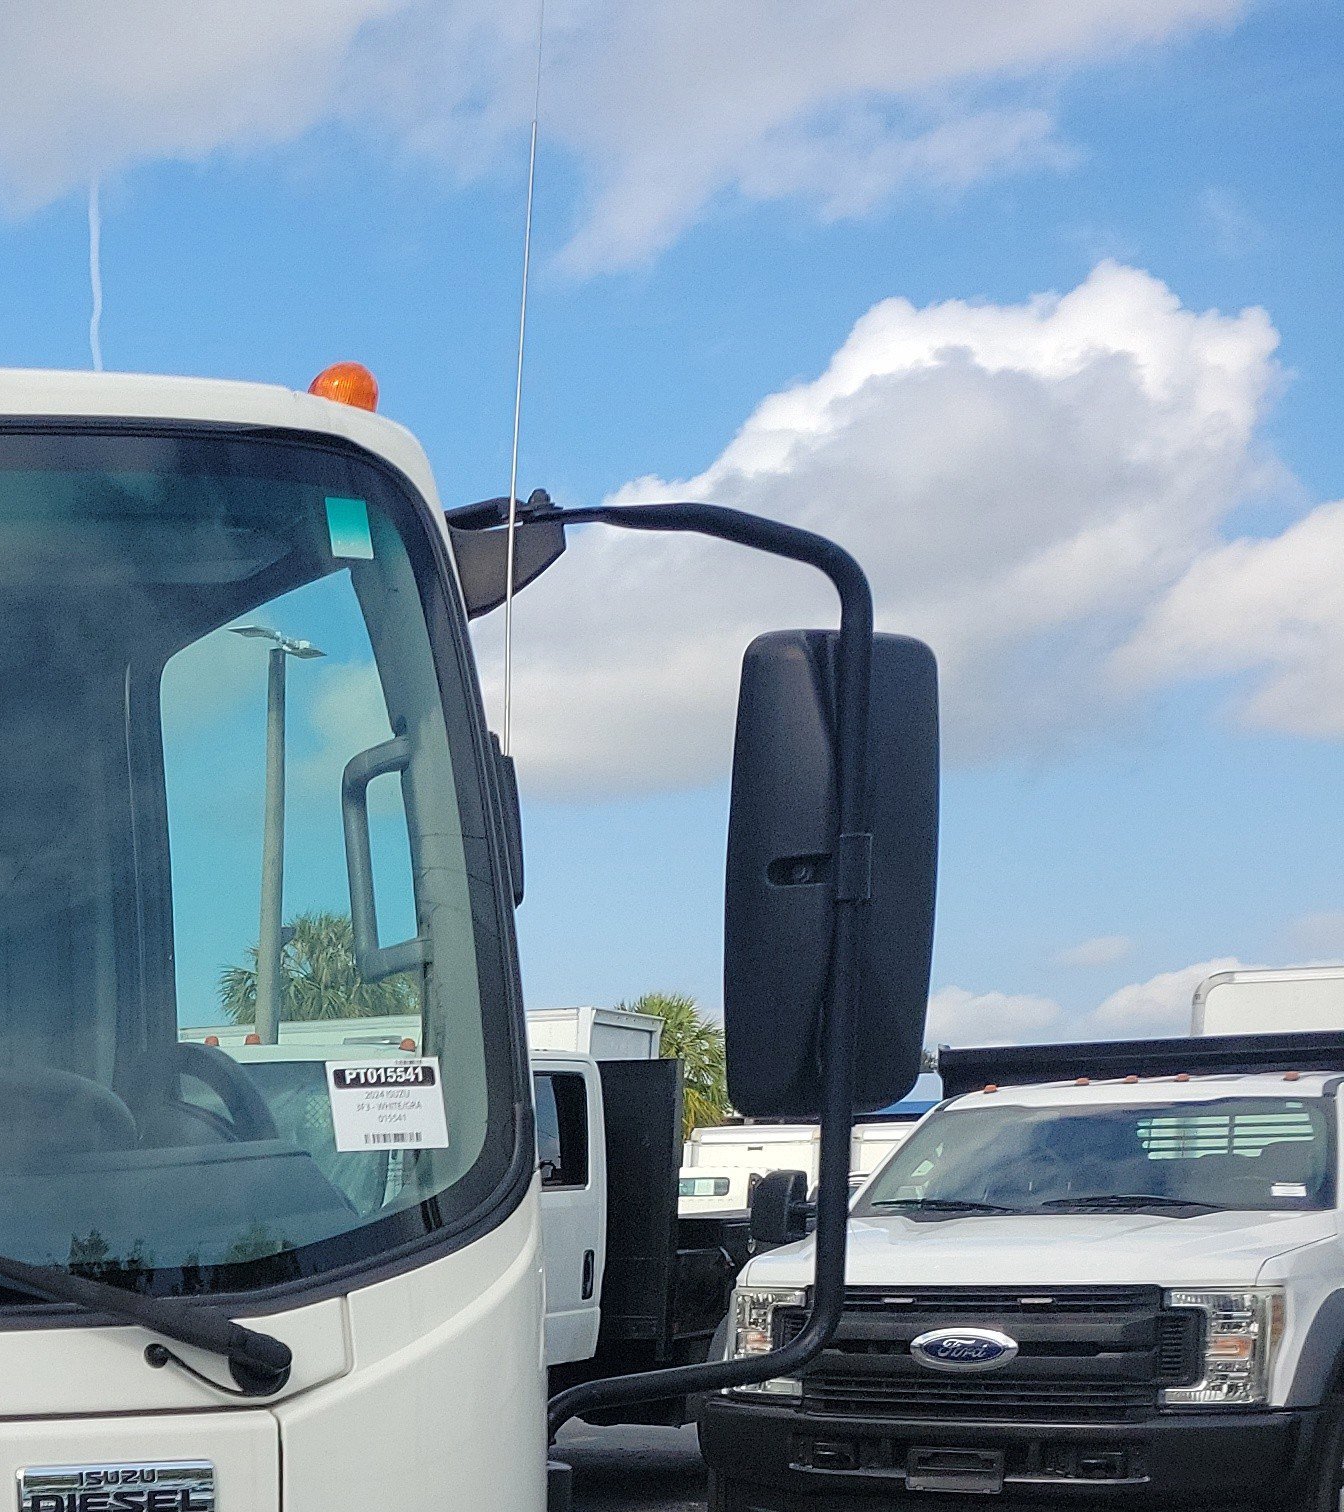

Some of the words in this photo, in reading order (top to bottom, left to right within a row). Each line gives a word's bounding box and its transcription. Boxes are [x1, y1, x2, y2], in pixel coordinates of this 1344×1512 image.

[344, 1066, 424, 1085] PT015541
[937, 1338, 989, 1358] Ford
[77, 1469, 159, 1487] ISUZU
